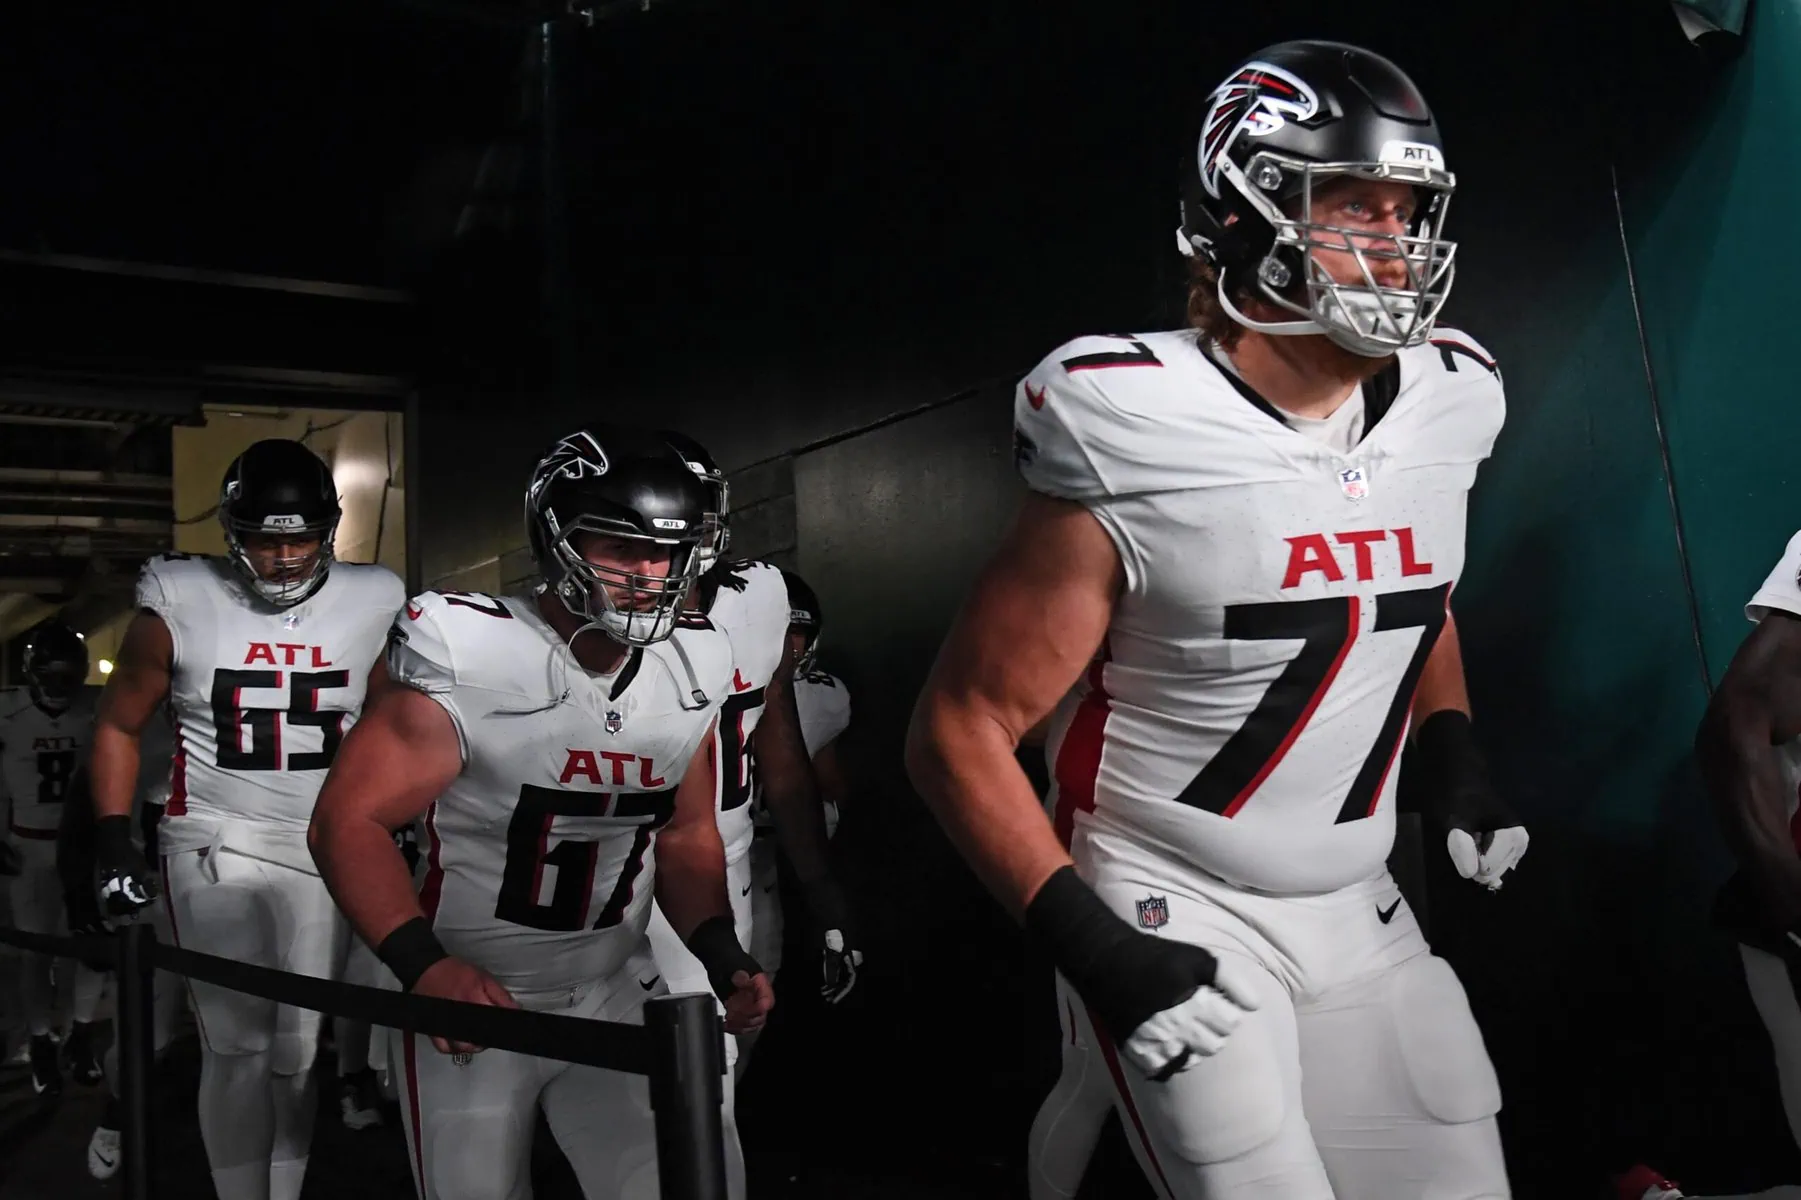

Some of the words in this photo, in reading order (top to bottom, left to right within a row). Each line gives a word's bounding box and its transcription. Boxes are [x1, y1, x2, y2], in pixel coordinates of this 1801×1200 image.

[1404, 147, 1434, 161] ATL
[273, 517, 295, 525] ATL
[663, 520, 680, 528] ATL
[1280, 527, 1432, 589] ATL
[244, 642, 332, 667] ATL
[211, 668, 349, 771] 65
[1173, 580, 1453, 825] 77
[32, 737, 82, 750] ATL
[37, 751, 76, 803] 8
[560, 748, 665, 787] ATL
[494, 783, 678, 931] 67
